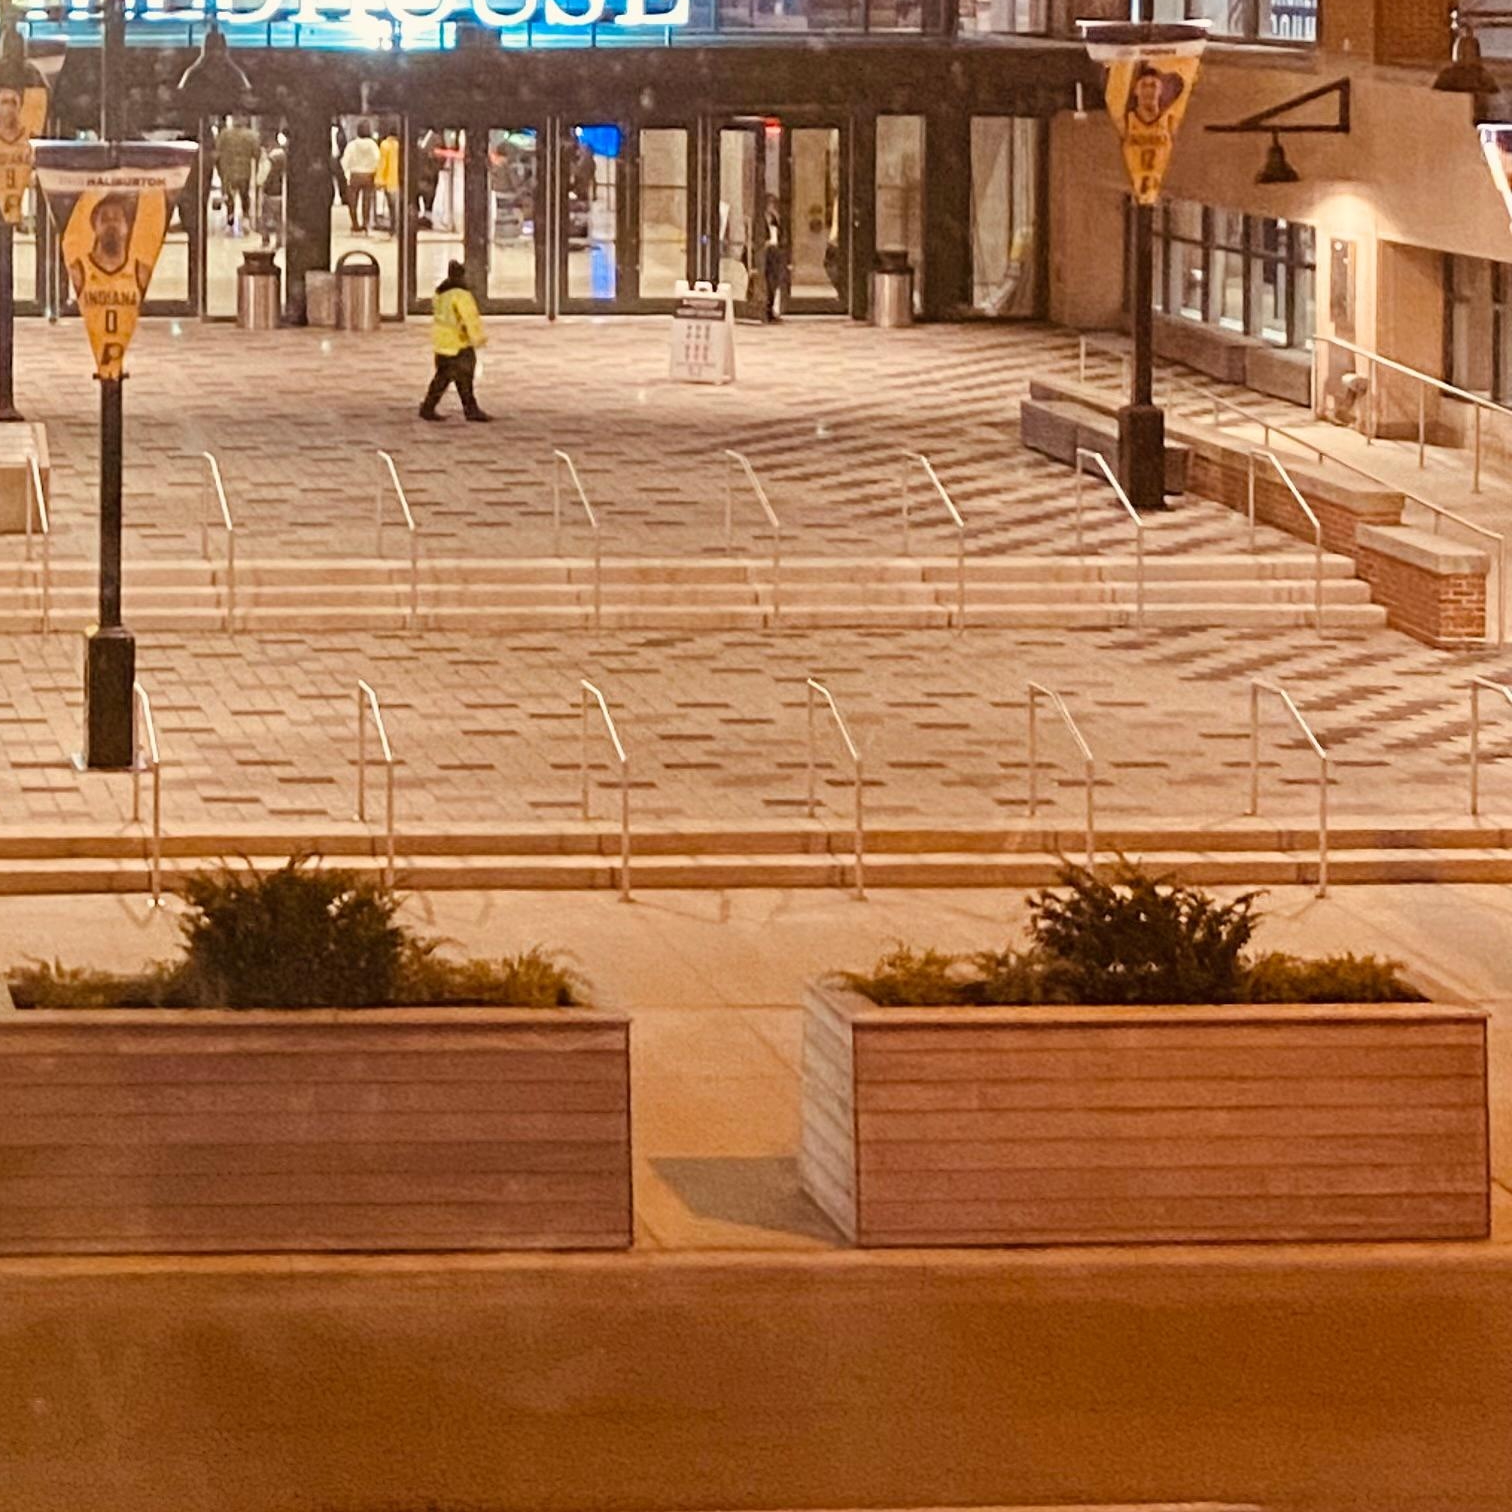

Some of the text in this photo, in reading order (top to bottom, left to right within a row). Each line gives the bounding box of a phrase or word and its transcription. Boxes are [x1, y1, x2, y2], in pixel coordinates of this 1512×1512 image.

[86, 176, 167, 187] HALIBURTON
[83, 289, 138, 307] INDIANA
[105, 309, 118, 334] 0
